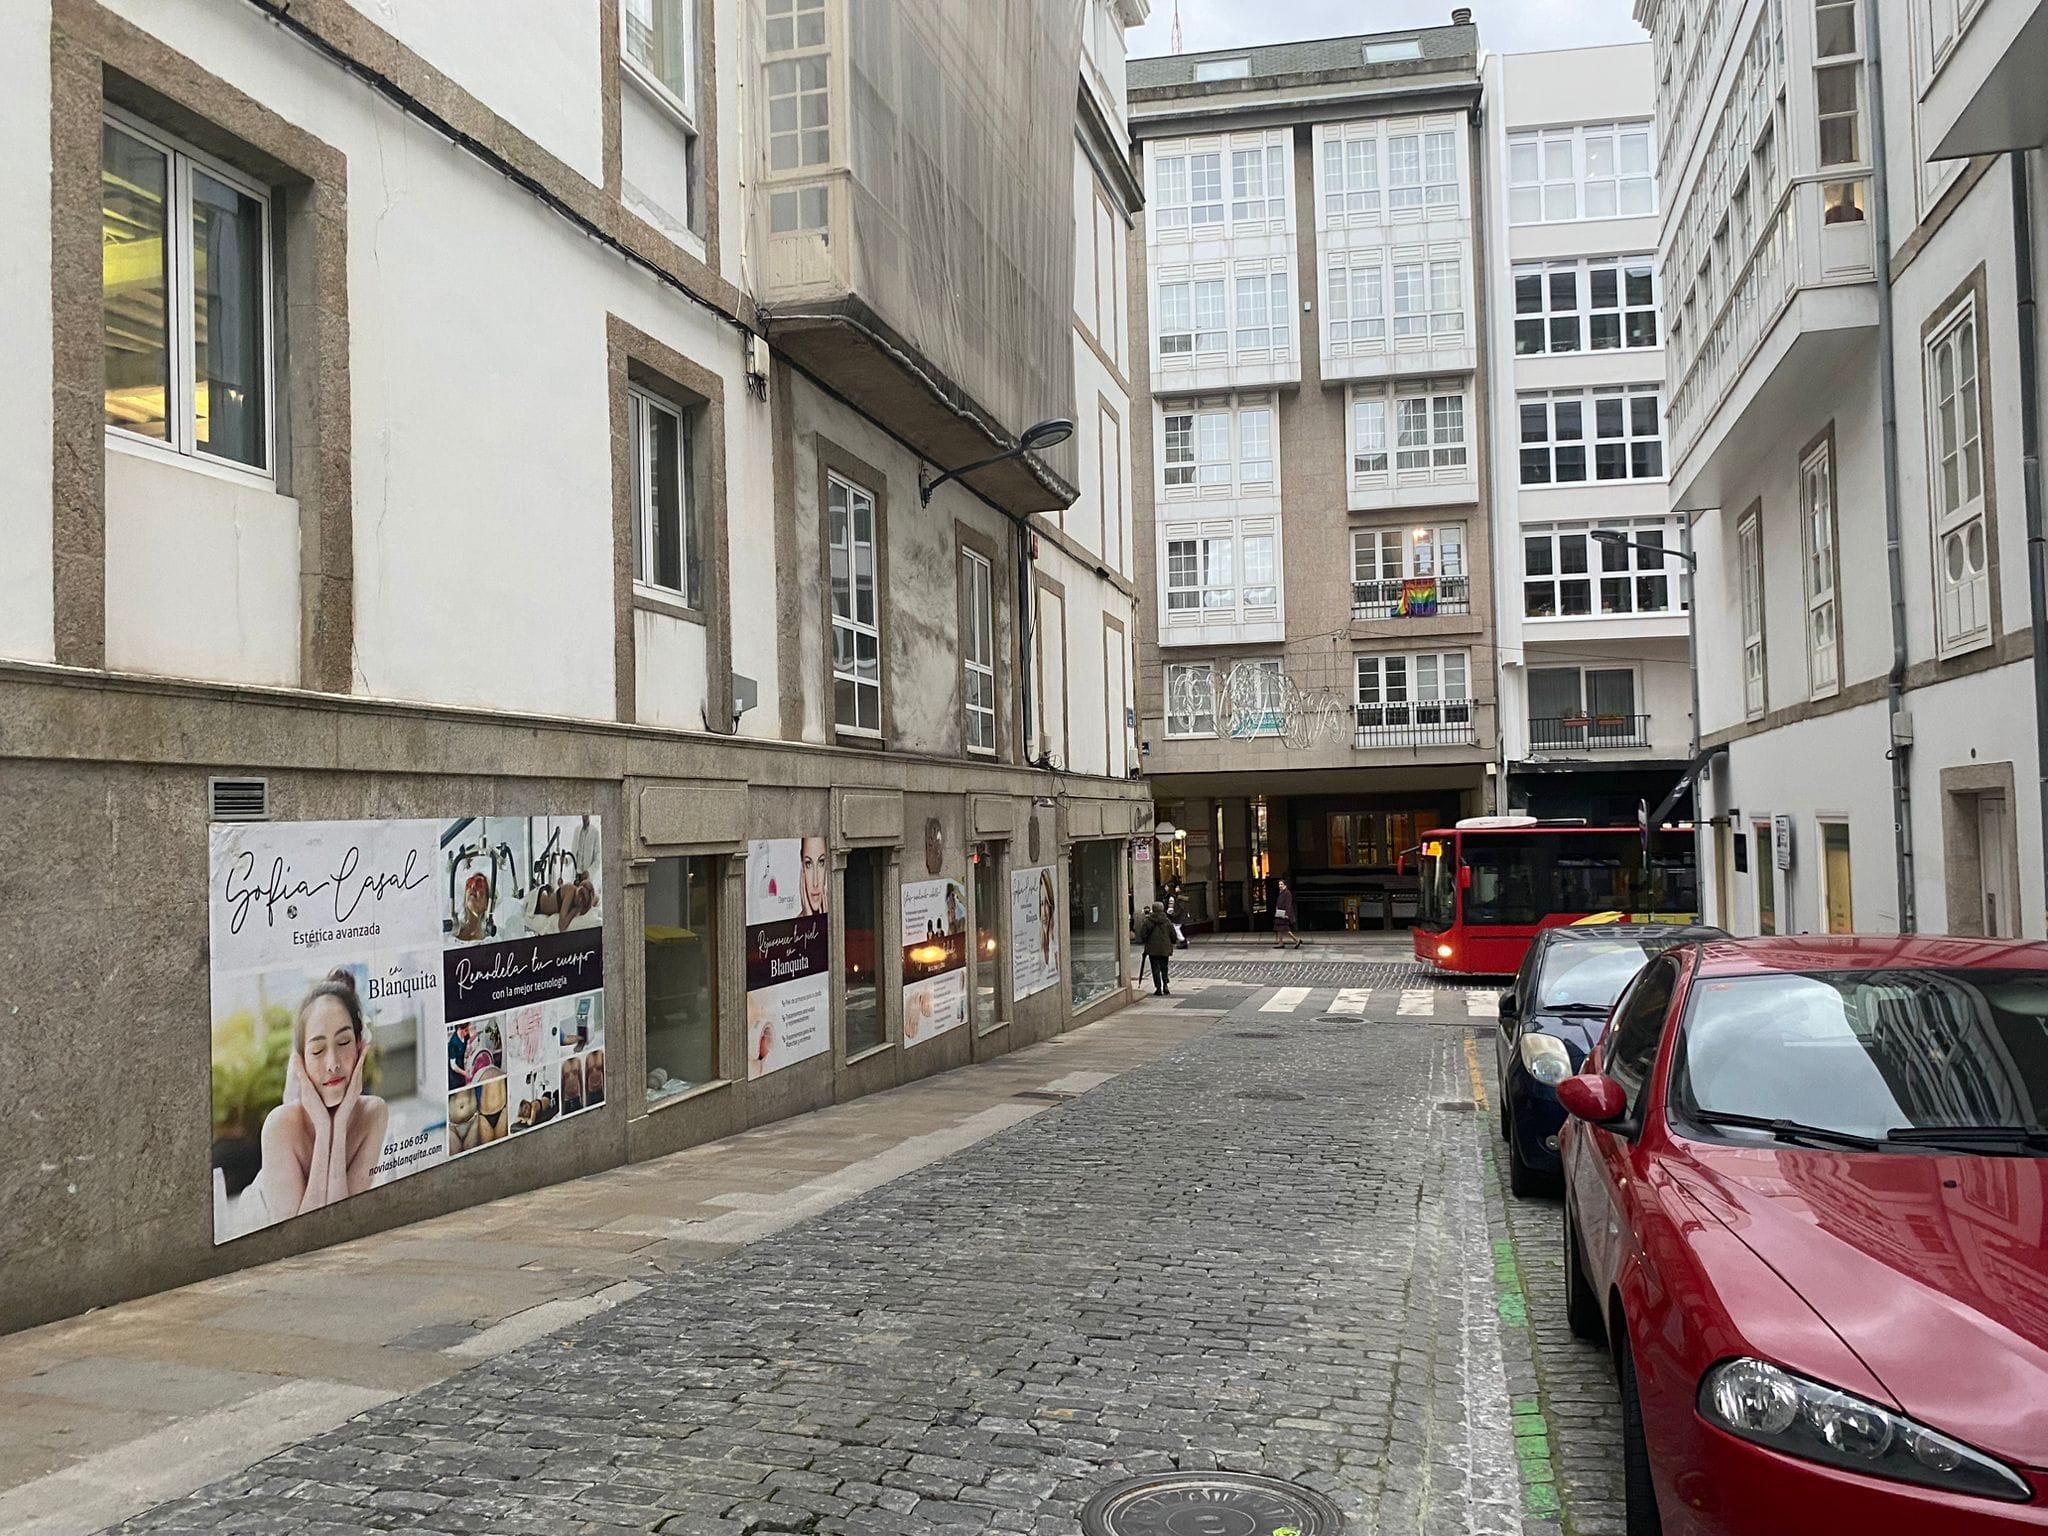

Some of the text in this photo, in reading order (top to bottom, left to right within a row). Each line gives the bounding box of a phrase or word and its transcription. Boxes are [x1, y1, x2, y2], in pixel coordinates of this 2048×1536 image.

[329, 846, 430, 923] Casal
[293, 922, 381, 945] Estética avanzada
[389, 965, 403, 976] en
[455, 946, 595, 1000] Remodela tu cuerpo
[770, 953, 810, 978] Blanquita
[368, 970, 437, 1000] Blanquita
[491, 990, 506, 1001] con
[505, 986, 513, 998] la
[513, 983, 534, 998] mejor
[383, 1142, 399, 1156] 652
[414, 1132, 429, 1145] 059
[368, 1144, 443, 1177] noviasblanquita.com
